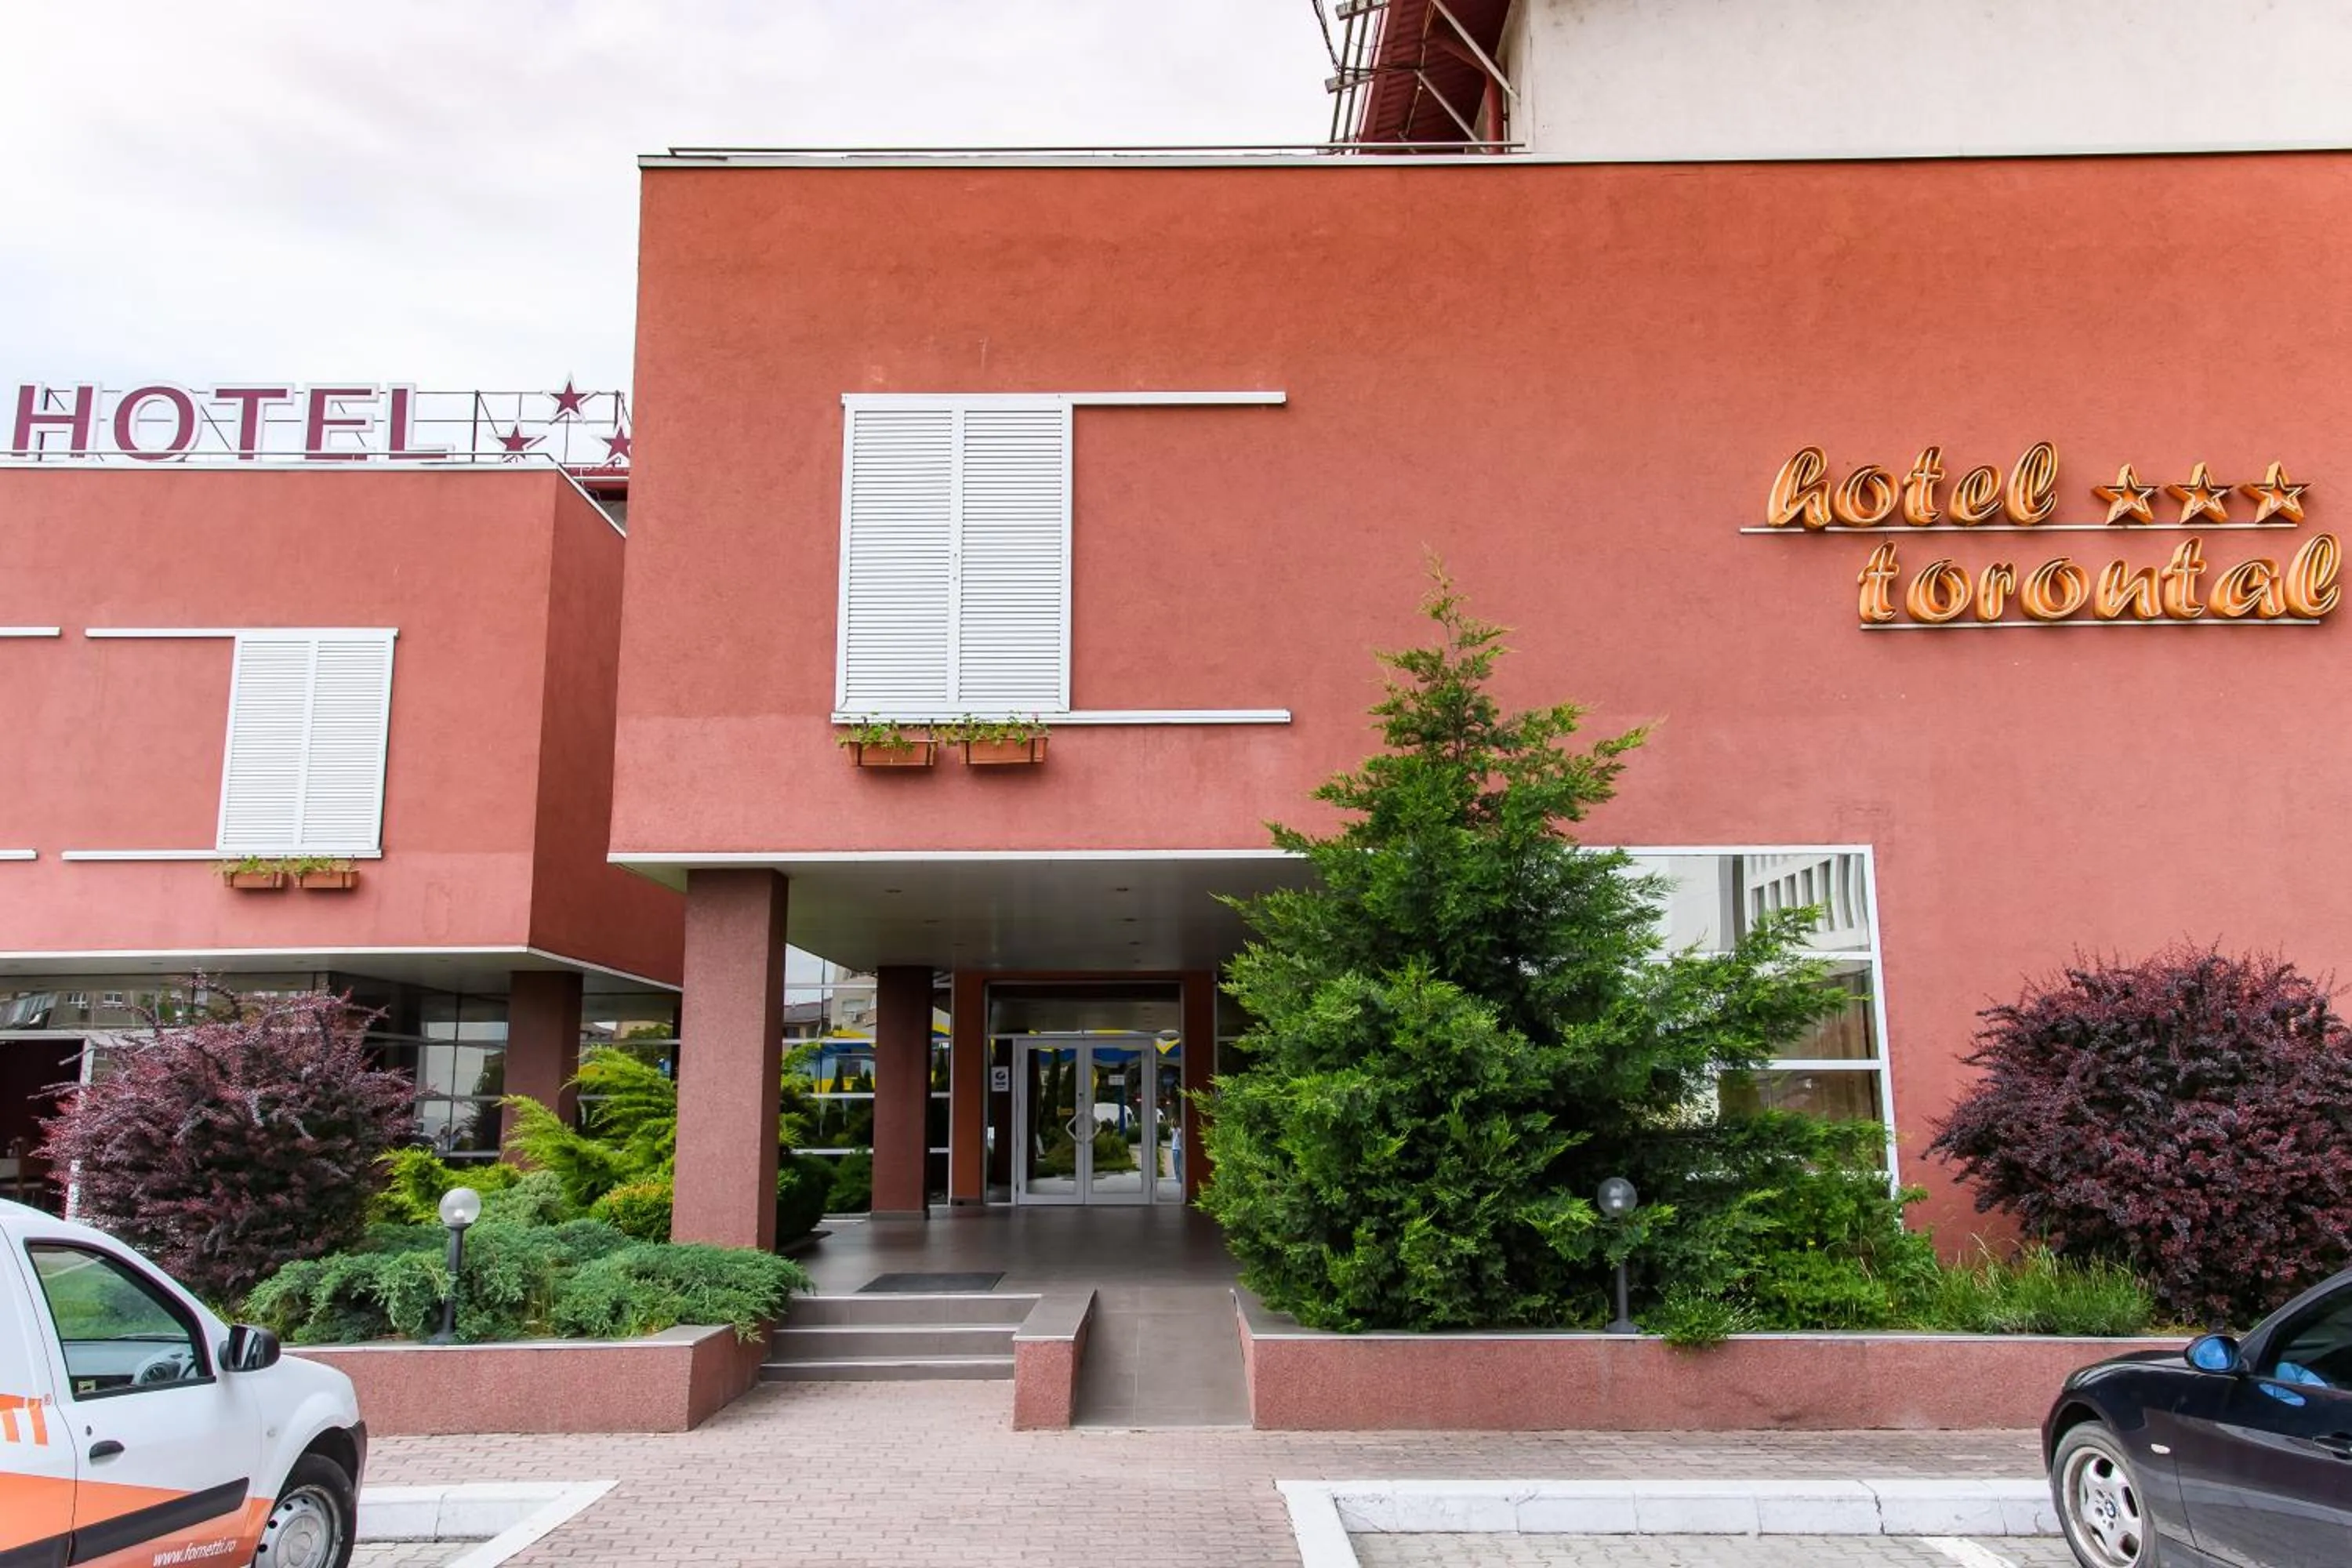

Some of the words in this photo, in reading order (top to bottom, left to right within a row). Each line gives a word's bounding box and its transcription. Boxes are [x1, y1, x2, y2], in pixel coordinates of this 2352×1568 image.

[8, 379, 455, 464] HOTEL
[1767, 441, 2059, 528] hotel
[1858, 532, 2342, 622] torontal
